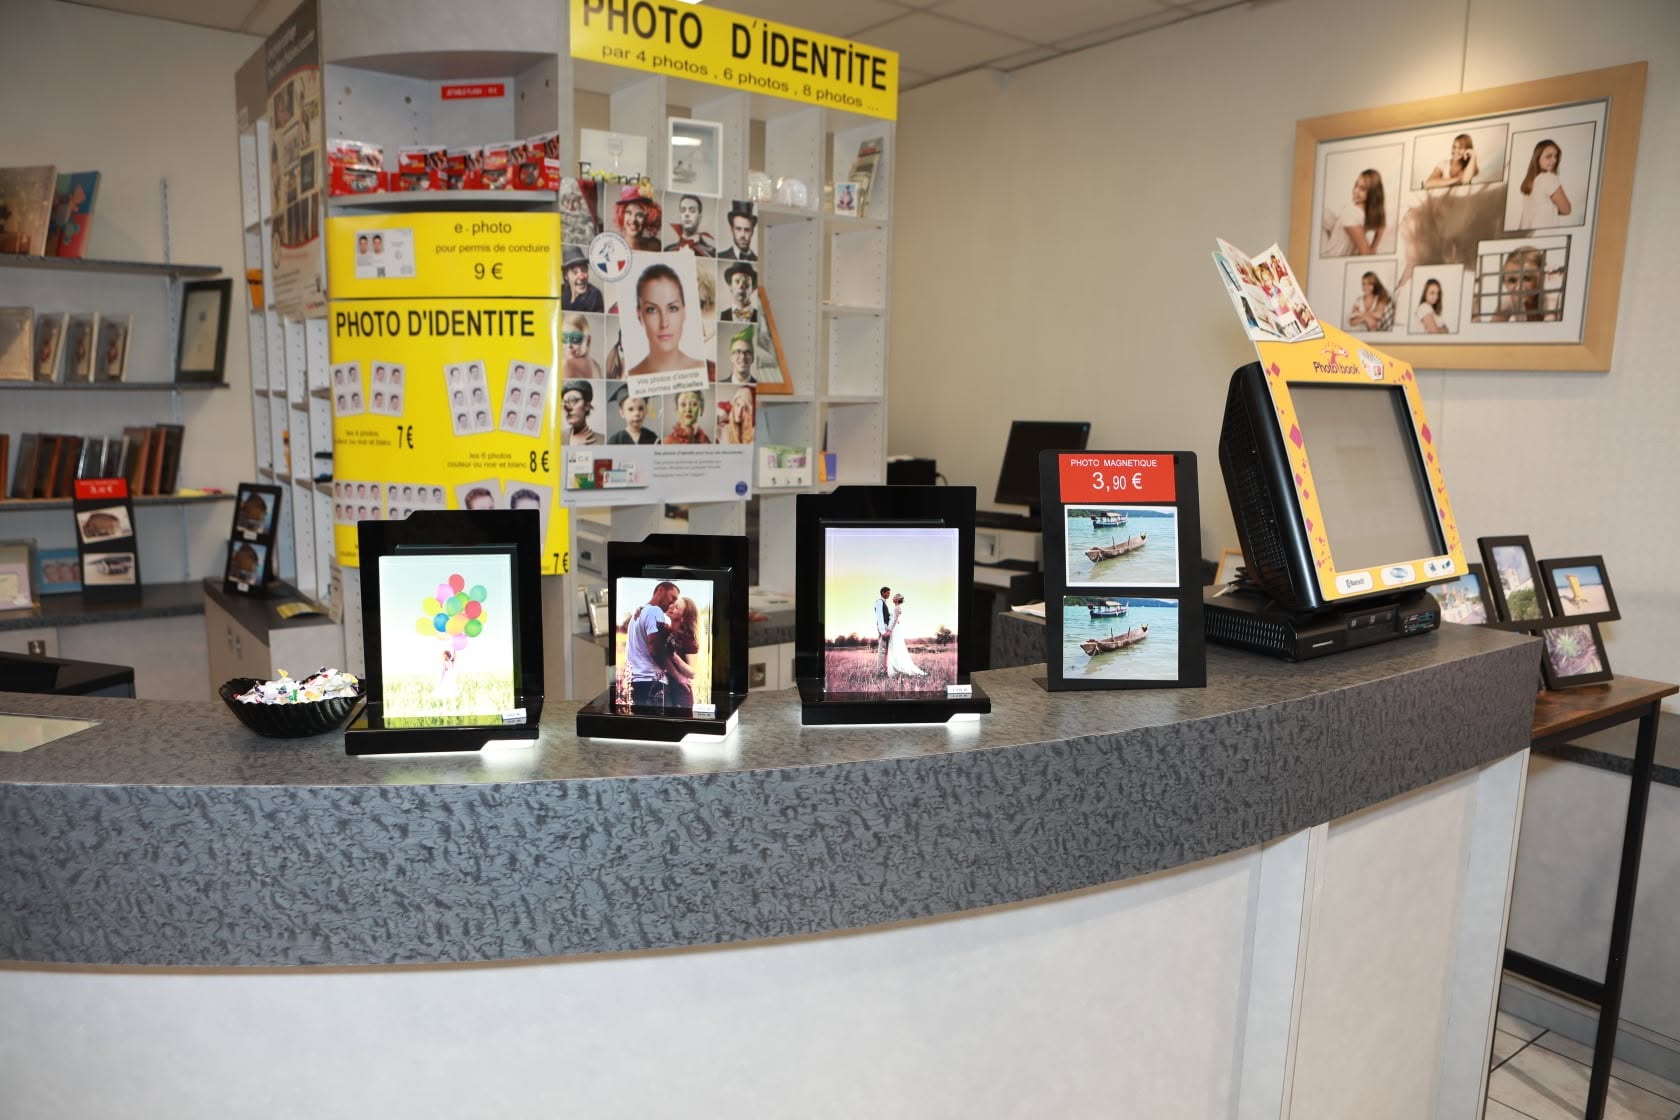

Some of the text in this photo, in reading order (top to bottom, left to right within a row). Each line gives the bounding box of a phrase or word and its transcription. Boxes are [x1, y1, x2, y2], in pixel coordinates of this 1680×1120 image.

[583, 0, 703, 49] PHOTO
[602, 45, 630, 59] par
[636, 51, 646, 62] 4
[652, 54, 708, 75] photos
[723, 67, 733, 80] 6
[738, 72, 789, 93] photos
[802, 84, 812, 97] 8
[816, 88, 863, 107] photos
[454, 223, 463, 234] e
[472, 221, 512, 236] photo
[436, 242, 550, 254] pour permis de conduire
[474, 262, 503, 280] 9 €
[336, 310, 535, 337] PHOTO D'IDENTITE
[397, 425, 414, 449] 7 €
[529, 450, 550, 473] 8 €
[1070, 459, 1157, 467] PHOTO MAGNETIQUE
[1132, 472, 1142, 490] €
[553, 551, 569, 574] 7 €
